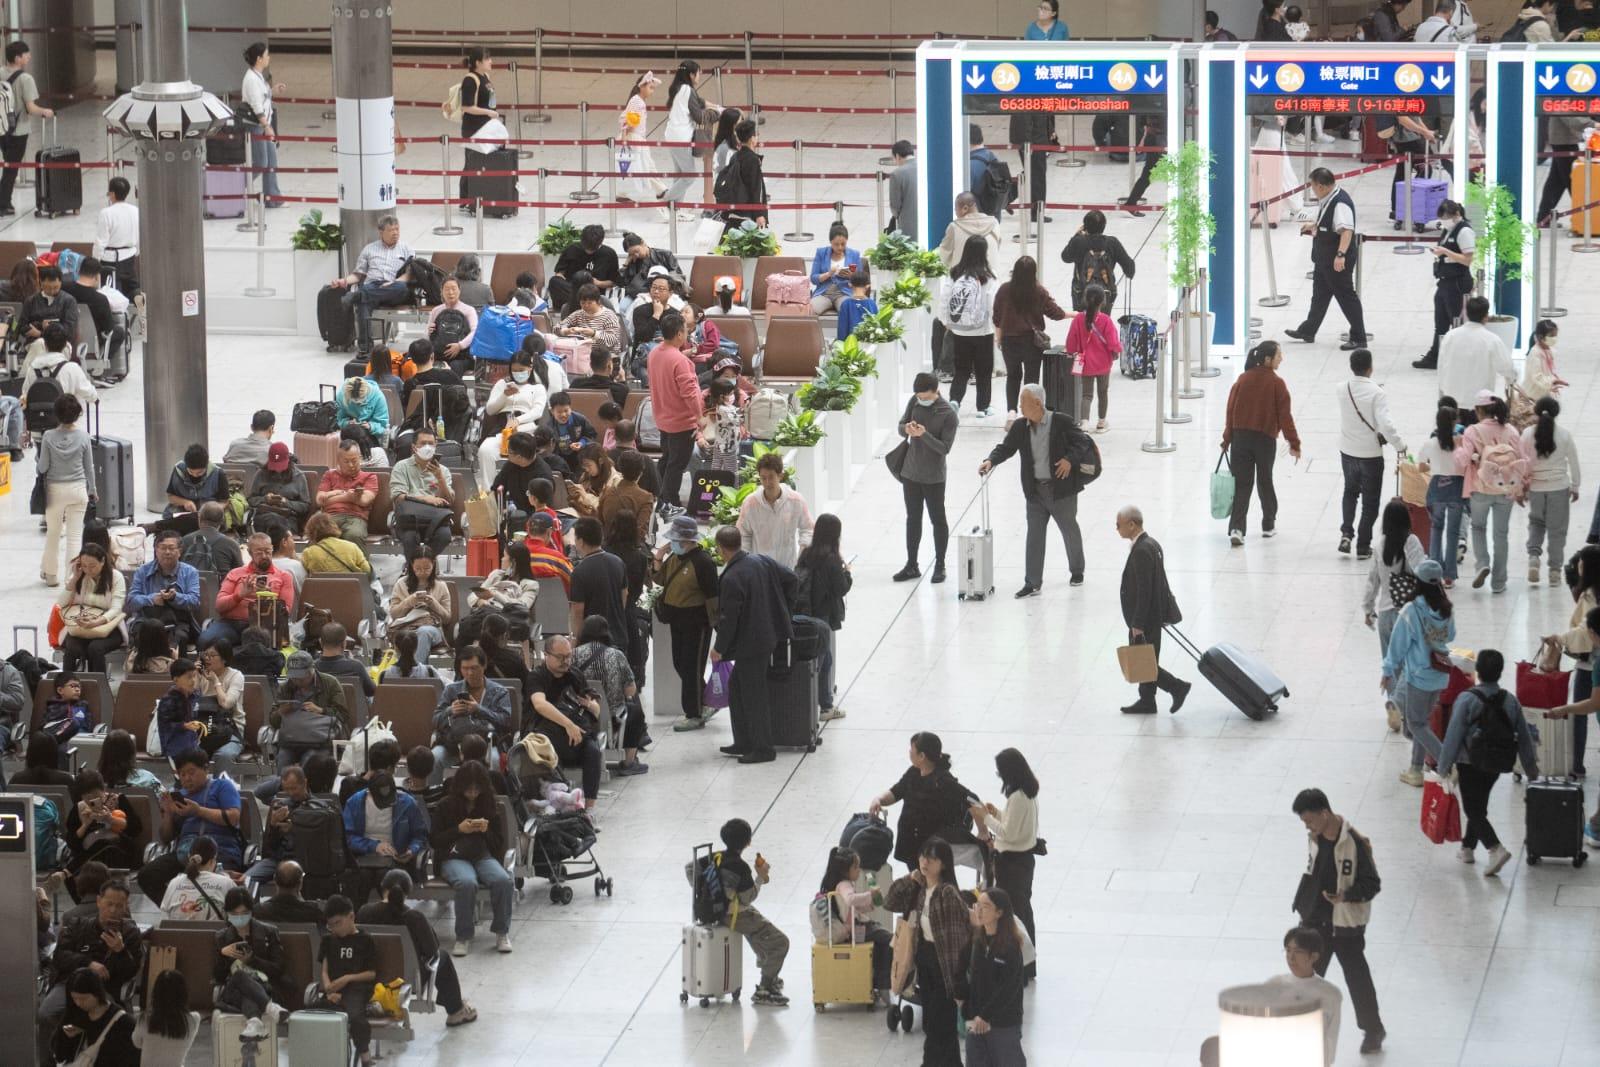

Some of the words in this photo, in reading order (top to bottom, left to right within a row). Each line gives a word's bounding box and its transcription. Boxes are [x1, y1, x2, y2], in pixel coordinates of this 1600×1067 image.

[997, 69, 1016, 84] 3A
[1034, 65, 1093, 80] 檢票閘口
[1112, 69, 1133, 84] 4A
[1280, 70, 1300, 85] 5A
[1320, 65, 1379, 80] 檢票閘口
[1398, 70, 1420, 86] 6A
[1571, 70, 1592, 86] 7A
[1055, 81, 1073, 90] Gate
[1340, 82, 1359, 90] Gate
[340, 947, 353, 959] FG
